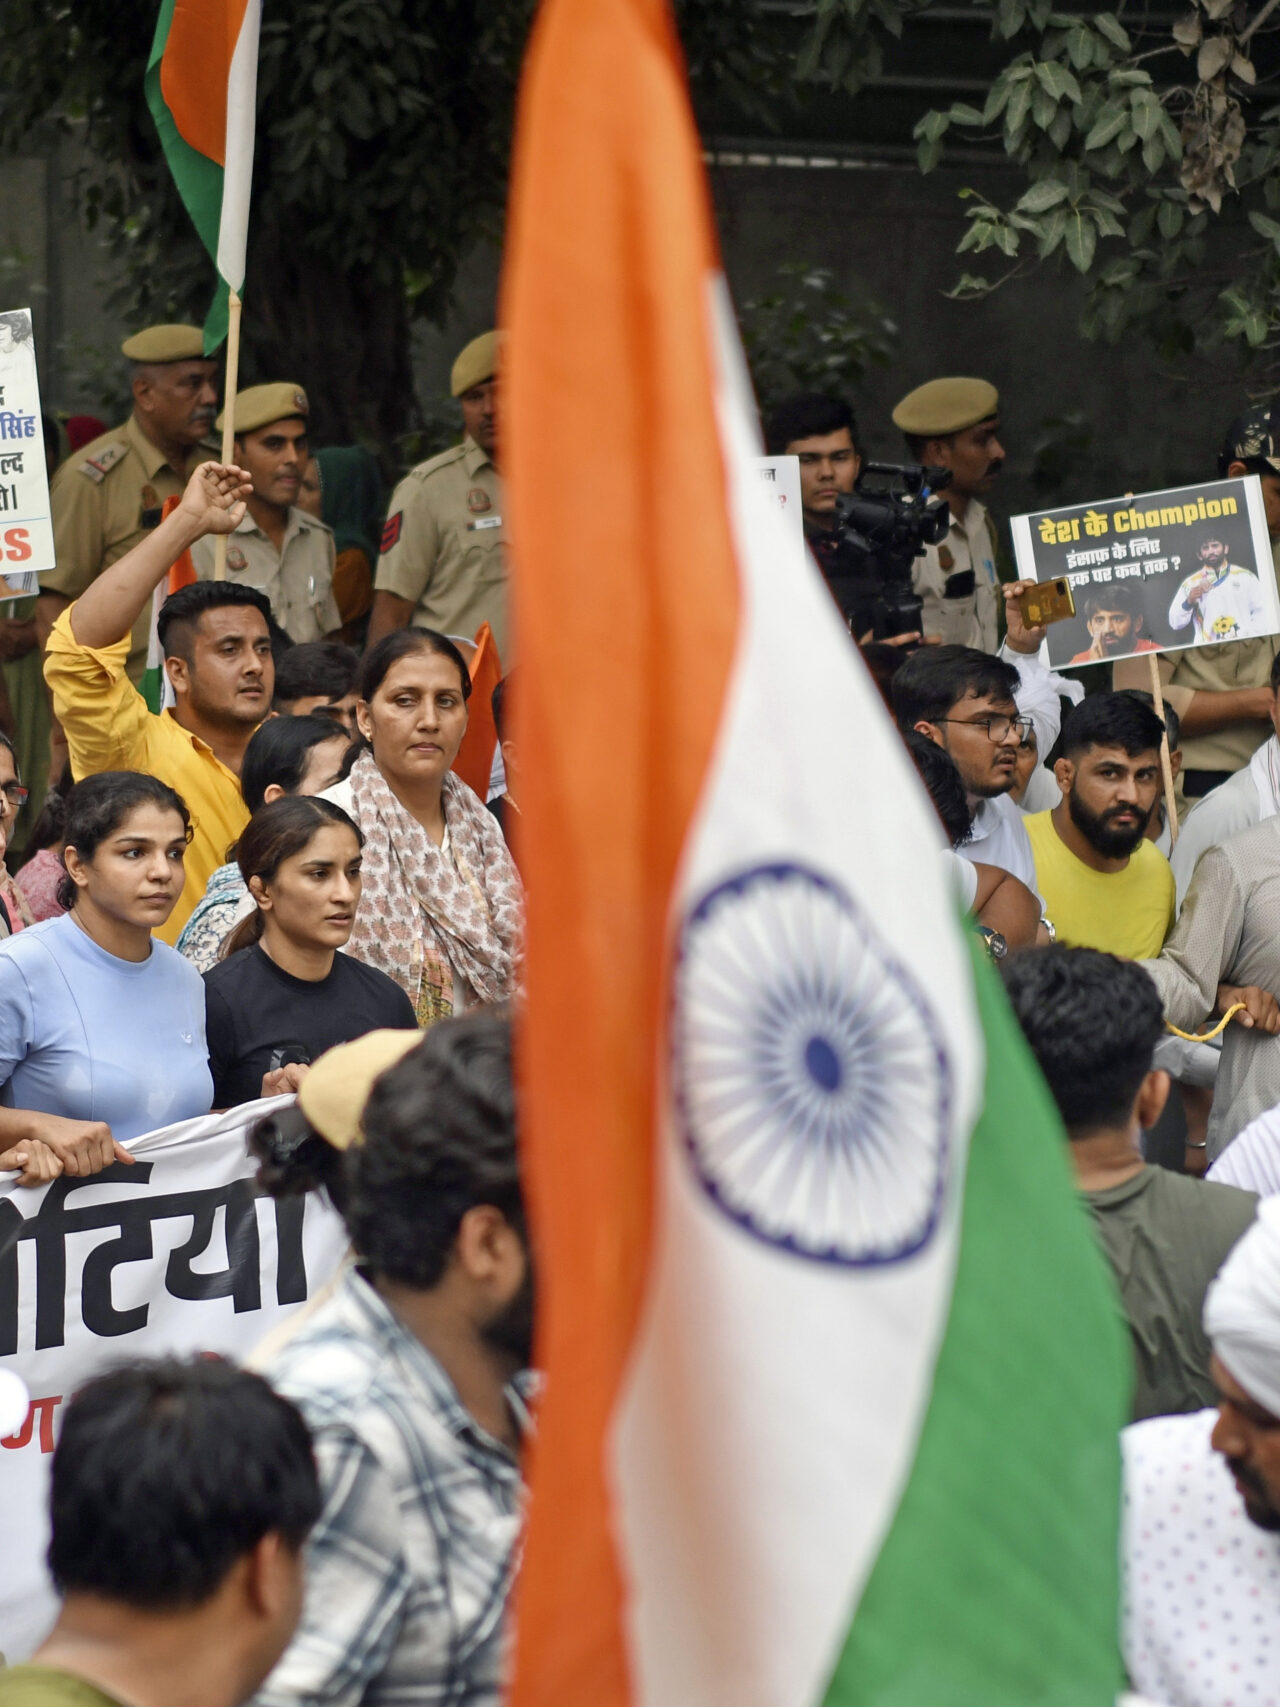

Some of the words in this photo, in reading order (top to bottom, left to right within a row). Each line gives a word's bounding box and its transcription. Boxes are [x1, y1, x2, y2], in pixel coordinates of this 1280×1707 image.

[0, 409, 36, 440] सिंह
[1038, 518, 1080, 545] देश
[1083, 511, 1109, 537] के
[1113, 496, 1238, 534] Champion
[1111, 542, 1127, 560] के
[1129, 537, 1161, 557] लिए
[1091, 567, 1112, 583] पर
[1114, 562, 1141, 579] कब
[1143, 558, 1169, 575] तक
